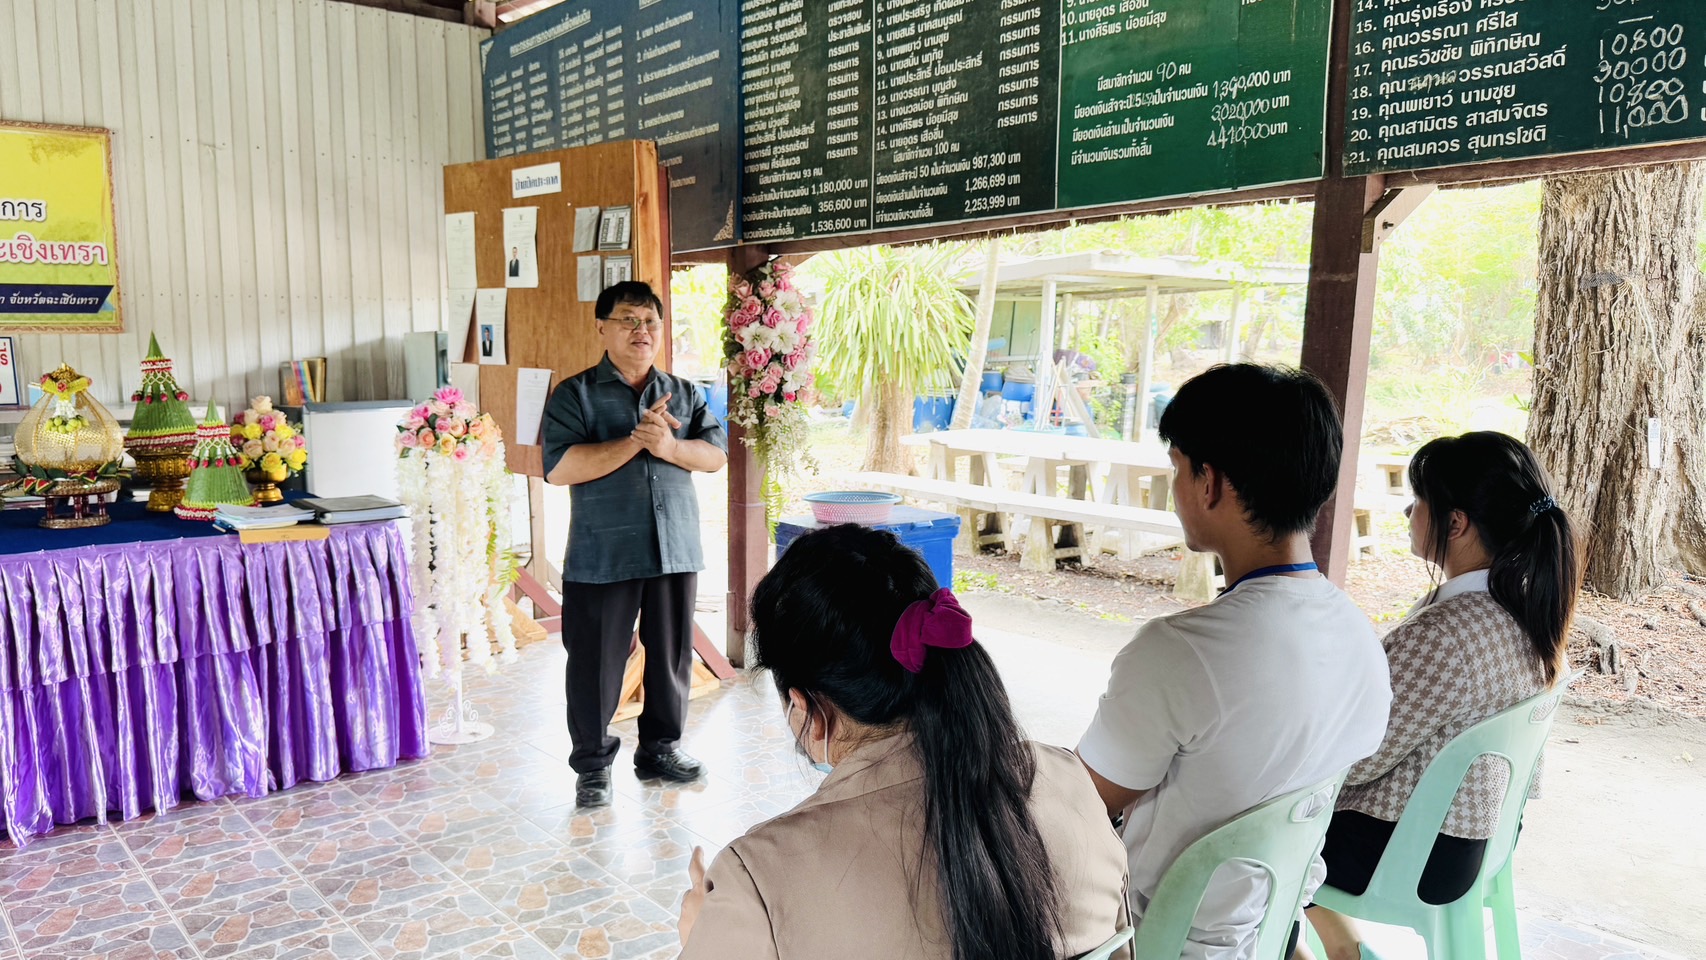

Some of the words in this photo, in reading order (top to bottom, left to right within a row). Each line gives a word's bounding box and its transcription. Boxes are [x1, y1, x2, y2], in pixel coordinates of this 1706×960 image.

[1357, 0, 1378, 13] 14.
[828, 9, 862, 28] ตรวจสอบ
[877, 18, 885, 29] 7.
[1000, 6, 1041, 27] กรรมการ
[1062, 10, 1077, 27] 10.
[1078, 4, 1116, 25] นายอุดร
[1000, 24, 1041, 44] กรรมการ
[1062, 29, 1078, 46] 11.
[1078, 17, 1122, 41] นางศิริพร
[1125, 10, 1167, 31] น้อยมีสุข
[1354, 41, 1375, 56] 16.
[1382, 22, 1469, 55] คุณวรรณา
[1476, 10, 1519, 33] ศรีใส
[1356, 19, 1378, 34] 15.
[877, 34, 885, 45] 8.
[828, 41, 860, 58] กรรมการ
[877, 50, 885, 61] 9.
[1000, 41, 1040, 61] กรรมการ
[1353, 63, 1373, 78] 17.
[1381, 45, 1463, 77] คุณธวัชชัย
[1470, 31, 1542, 58] พิทักษิณ
[828, 57, 860, 73] กรรมการ
[877, 64, 888, 76] 10.
[999, 59, 1040, 78] กรรมการ
[1351, 86, 1373, 100] 18.
[1379, 80, 1406, 99] คุณ
[1458, 44, 1567, 83] วรรณสวัสดิ์
[828, 71, 859, 87] กรรมการ
[1097, 69, 1153, 92] มีสมาชิกจำนวน
[1156, 61, 1177, 82] 90
[1179, 62, 1192, 76] คน
[1273, 69, 1291, 84] บาท
[827, 86, 859, 102] กรรมการ
[877, 80, 888, 91] 11.
[877, 95, 888, 106] 12.
[890, 85, 930, 103] นางวรรณา
[932, 77, 957, 96] บุญส่ง
[998, 76, 1039, 95] กรรมการ
[827, 101, 859, 117] กรรมการ
[998, 93, 1039, 112] กรรมการ
[1271, 95, 1290, 109] บาท
[1351, 108, 1372, 121] 19.
[1378, 90, 1454, 120] คุณพเยาว์
[1461, 83, 1517, 105] นามซุย
[827, 116, 859, 131] กรรมการ
[877, 110, 888, 121] 13.
[997, 110, 1038, 129] กรรมการ
[1350, 128, 1372, 143] 20.
[1378, 115, 1459, 143] คุณสามิตร
[1465, 101, 1549, 127] สาสมจิตร
[827, 131, 859, 145] กรรมการ
[876, 125, 888, 136] 14.
[876, 139, 887, 151] 15.
[934, 142, 949, 156] 100
[950, 142, 960, 153] คน
[1071, 137, 1152, 166] มีจำนวนเงินรวมทั้งสิ้น
[1270, 122, 1288, 135] บาท
[1348, 151, 1371, 164] 21.
[1377, 137, 1461, 165] คุณสมควร
[1467, 124, 1547, 154] สุนทรโชติ
[827, 146, 858, 160] กรรมการ
[802, 168, 812, 178] 93
[919, 165, 930, 179] 50
[972, 152, 1007, 170] 987,300
[1008, 152, 1021, 167] บาท
[811, 178, 853, 196] 1,180,000
[854, 178, 868, 189] บาท
[965, 173, 1006, 193] 1,266,699
[1008, 173, 1021, 186] บาท
[1, 200, 43, 218] การ
[818, 198, 852, 213] 356,600
[854, 198, 867, 208] บาท
[964, 194, 1006, 214] 2,253,999
[1007, 195, 1021, 208] บาท
[810, 218, 851, 233] 1,536,600
[854, 218, 867, 229] บาท
[9, 291, 100, 305] จังหวัดฉะเชิงเทรา
